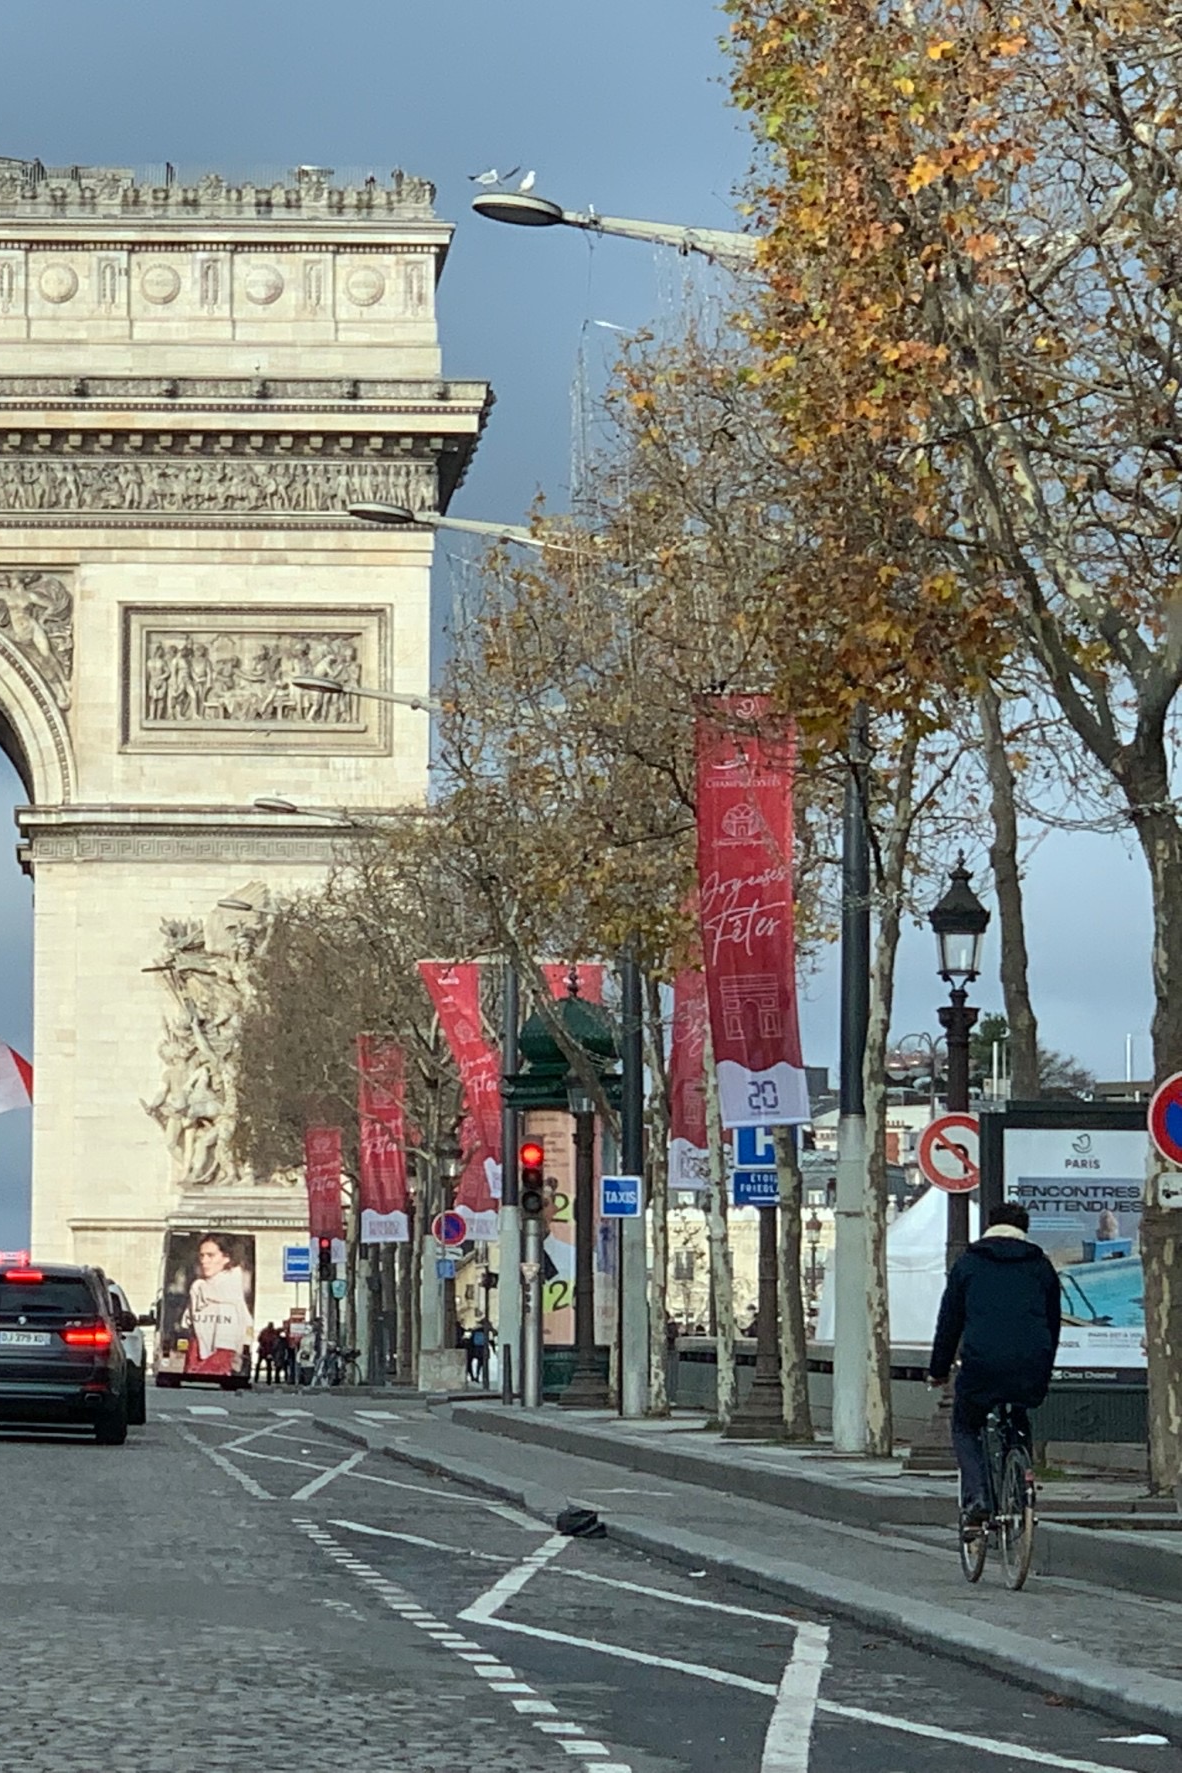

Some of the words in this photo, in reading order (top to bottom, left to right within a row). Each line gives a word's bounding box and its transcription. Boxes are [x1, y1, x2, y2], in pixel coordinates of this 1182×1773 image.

[702, 868, 787, 914] Joyeuses
[703, 899, 786, 967] Fêtes
[748, 1080, 779, 1110] 20
[1065, 1159, 1101, 1169] PARIS
[740, 1183, 777, 1194] FRIEDL
[1008, 1185, 1140, 1198] RENCONTRES
[605, 1190, 637, 1204] TAXIS
